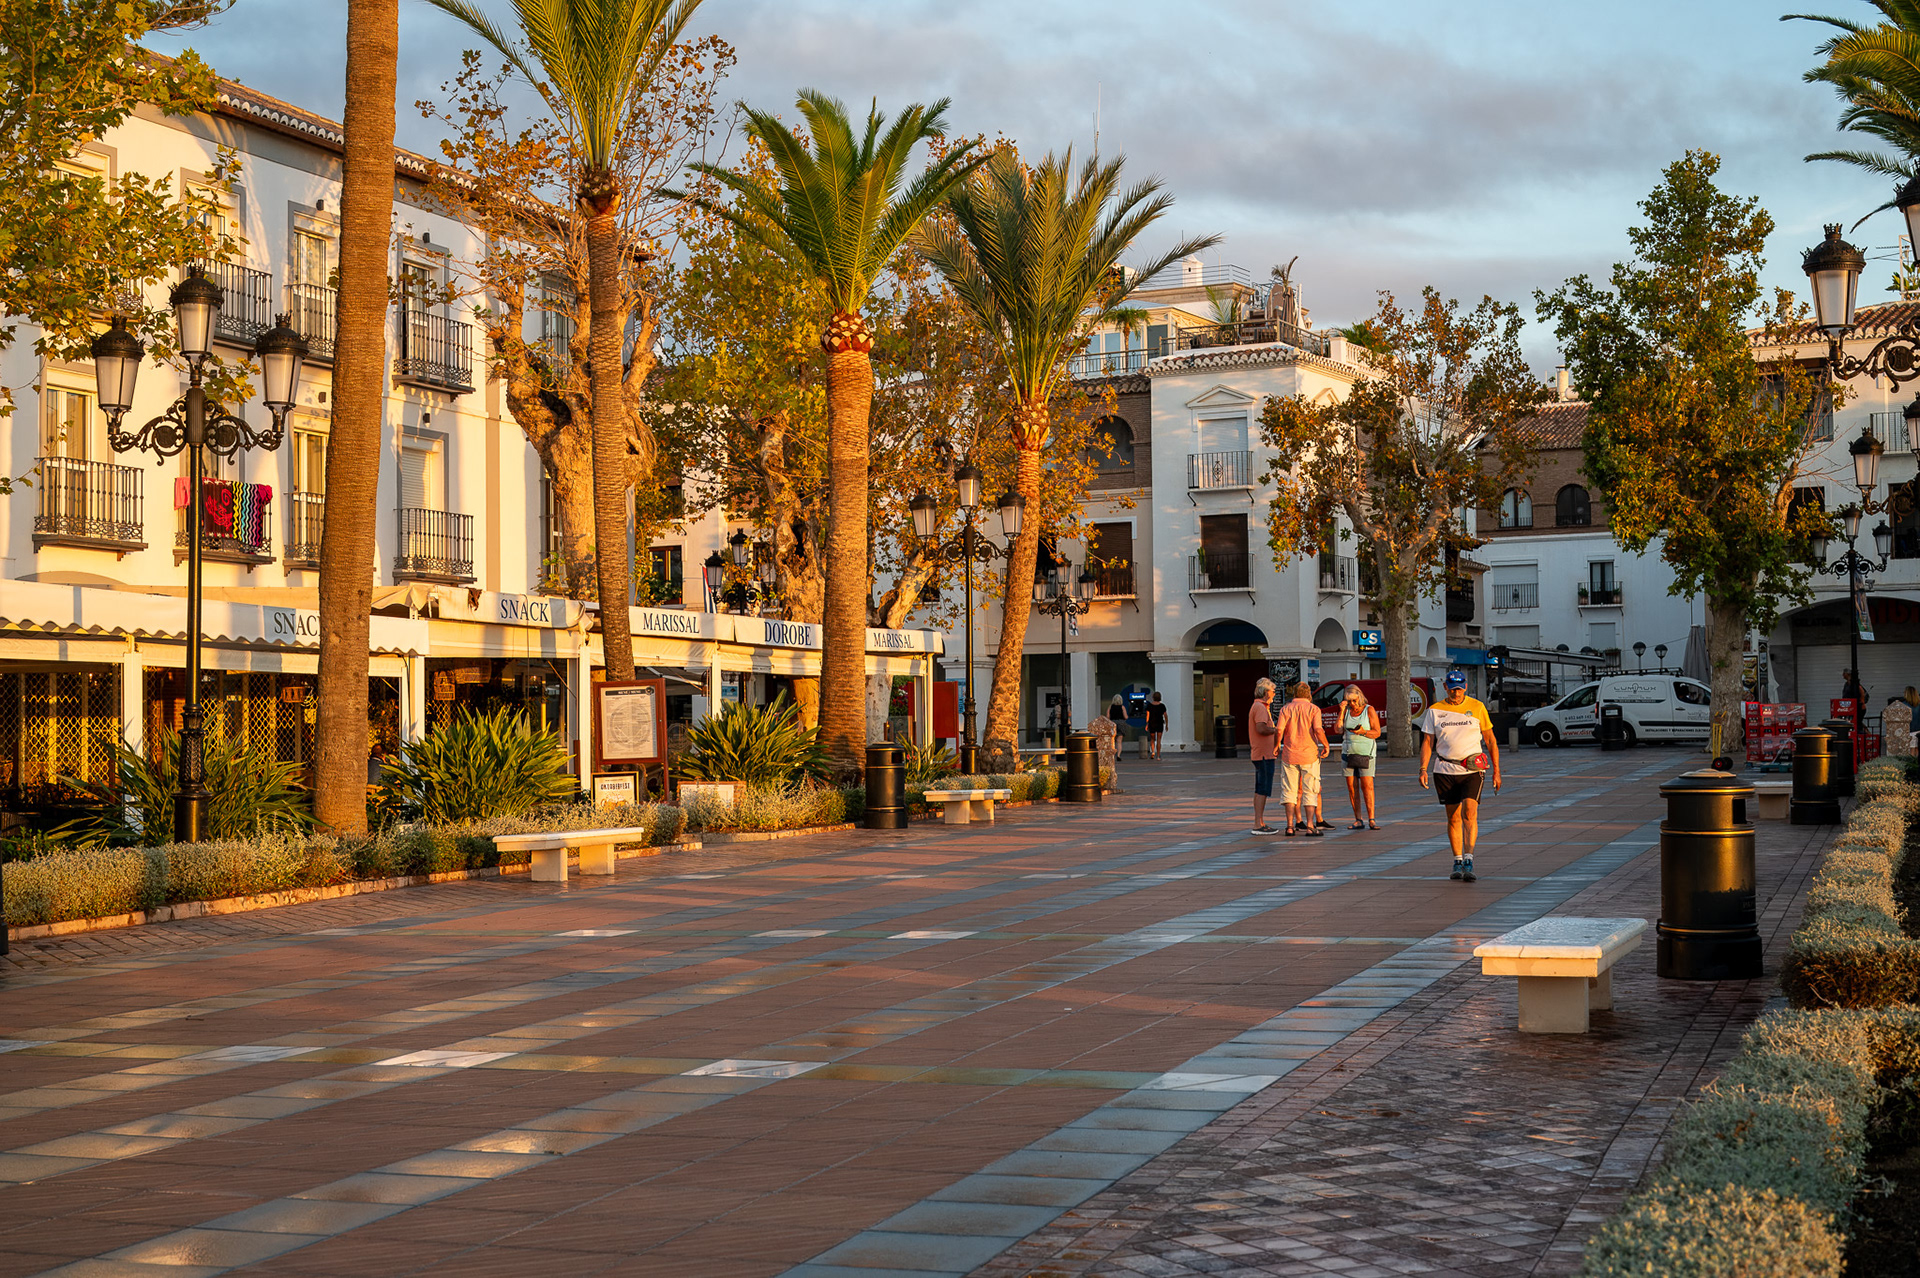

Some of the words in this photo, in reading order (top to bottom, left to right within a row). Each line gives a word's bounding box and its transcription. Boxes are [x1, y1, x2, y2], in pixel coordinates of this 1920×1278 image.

[500, 600, 550, 623] SNACK
[273, 611, 320, 637] SNAC
[642, 612, 700, 634] MARISSAL
[764, 621, 812, 646] DOROBE
[873, 632, 915, 649] MARISSAL
[600, 782, 631, 790] OKTOBERFEST
